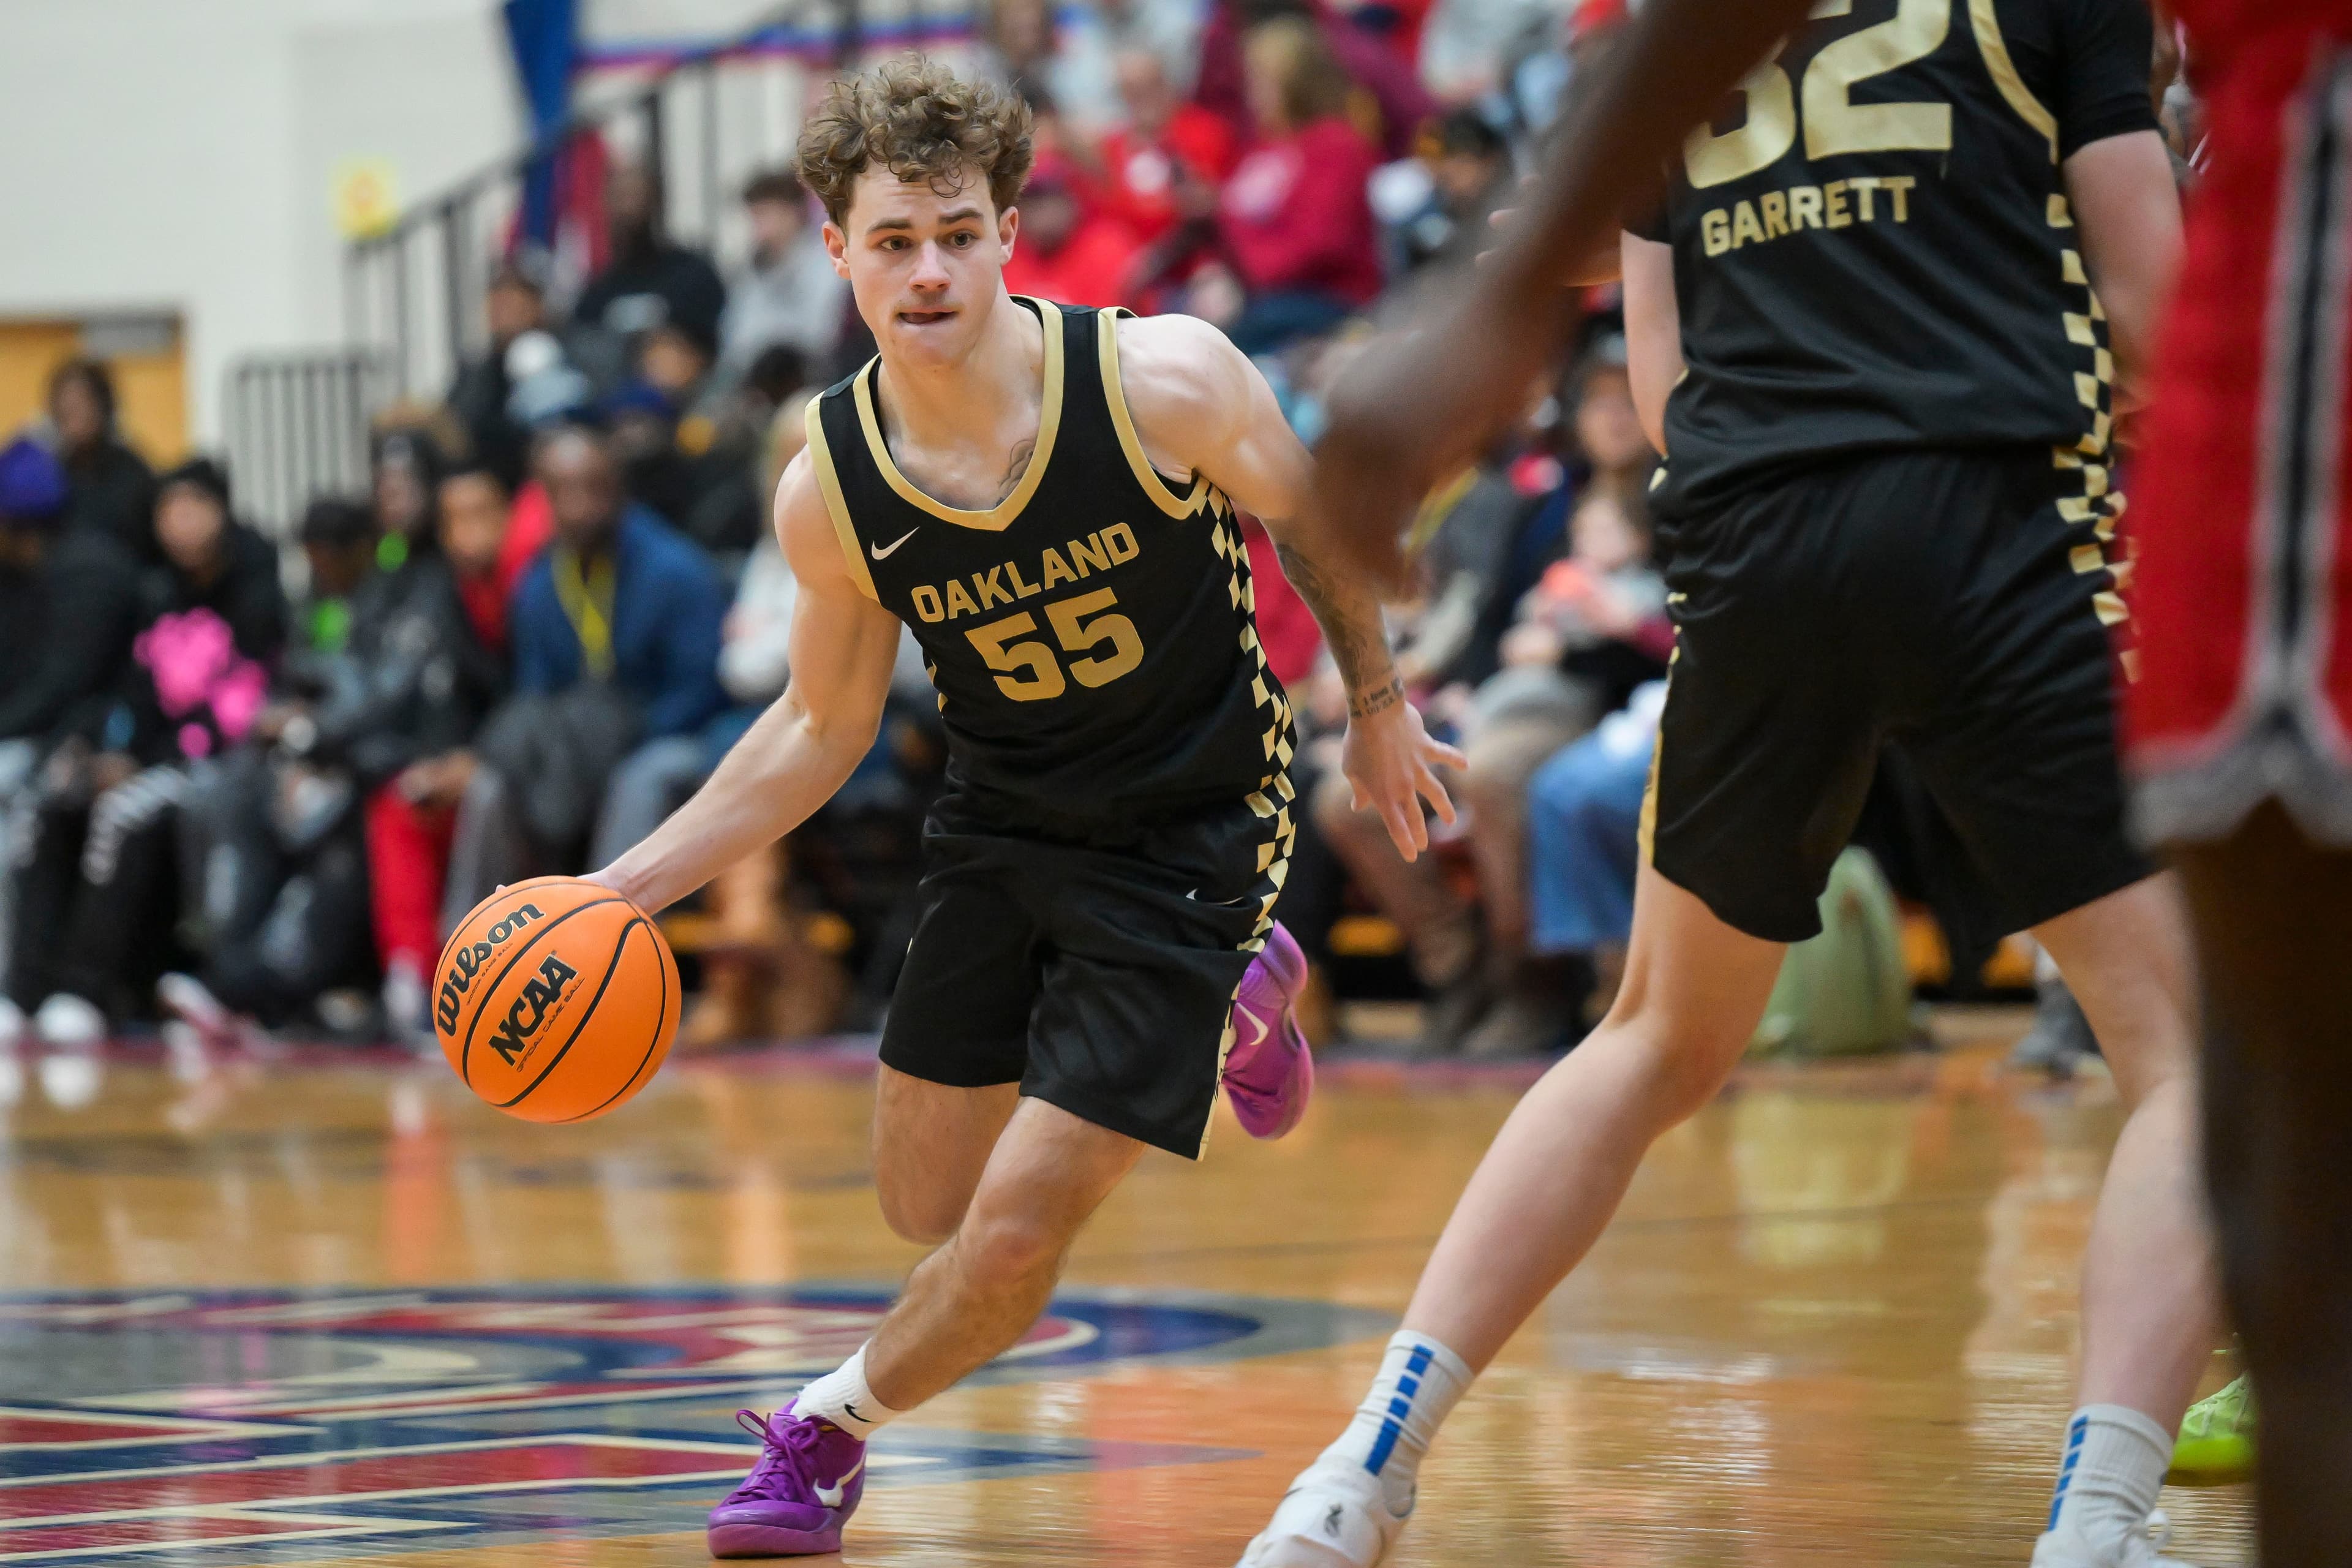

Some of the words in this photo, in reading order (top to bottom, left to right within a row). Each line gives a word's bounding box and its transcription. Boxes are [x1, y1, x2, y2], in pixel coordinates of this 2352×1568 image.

[1700, 176, 1916, 258] GARRETT
[911, 522, 1140, 623] OAKLAND
[964, 587, 1144, 702] 55
[438, 903, 546, 1037] Wilson
[481, 958, 497, 977] GAME
[497, 943, 513, 957] BALL
[488, 953, 579, 1067] NCAA
[543, 1003, 565, 1033] GAME
[564, 978, 586, 1002] BALL
